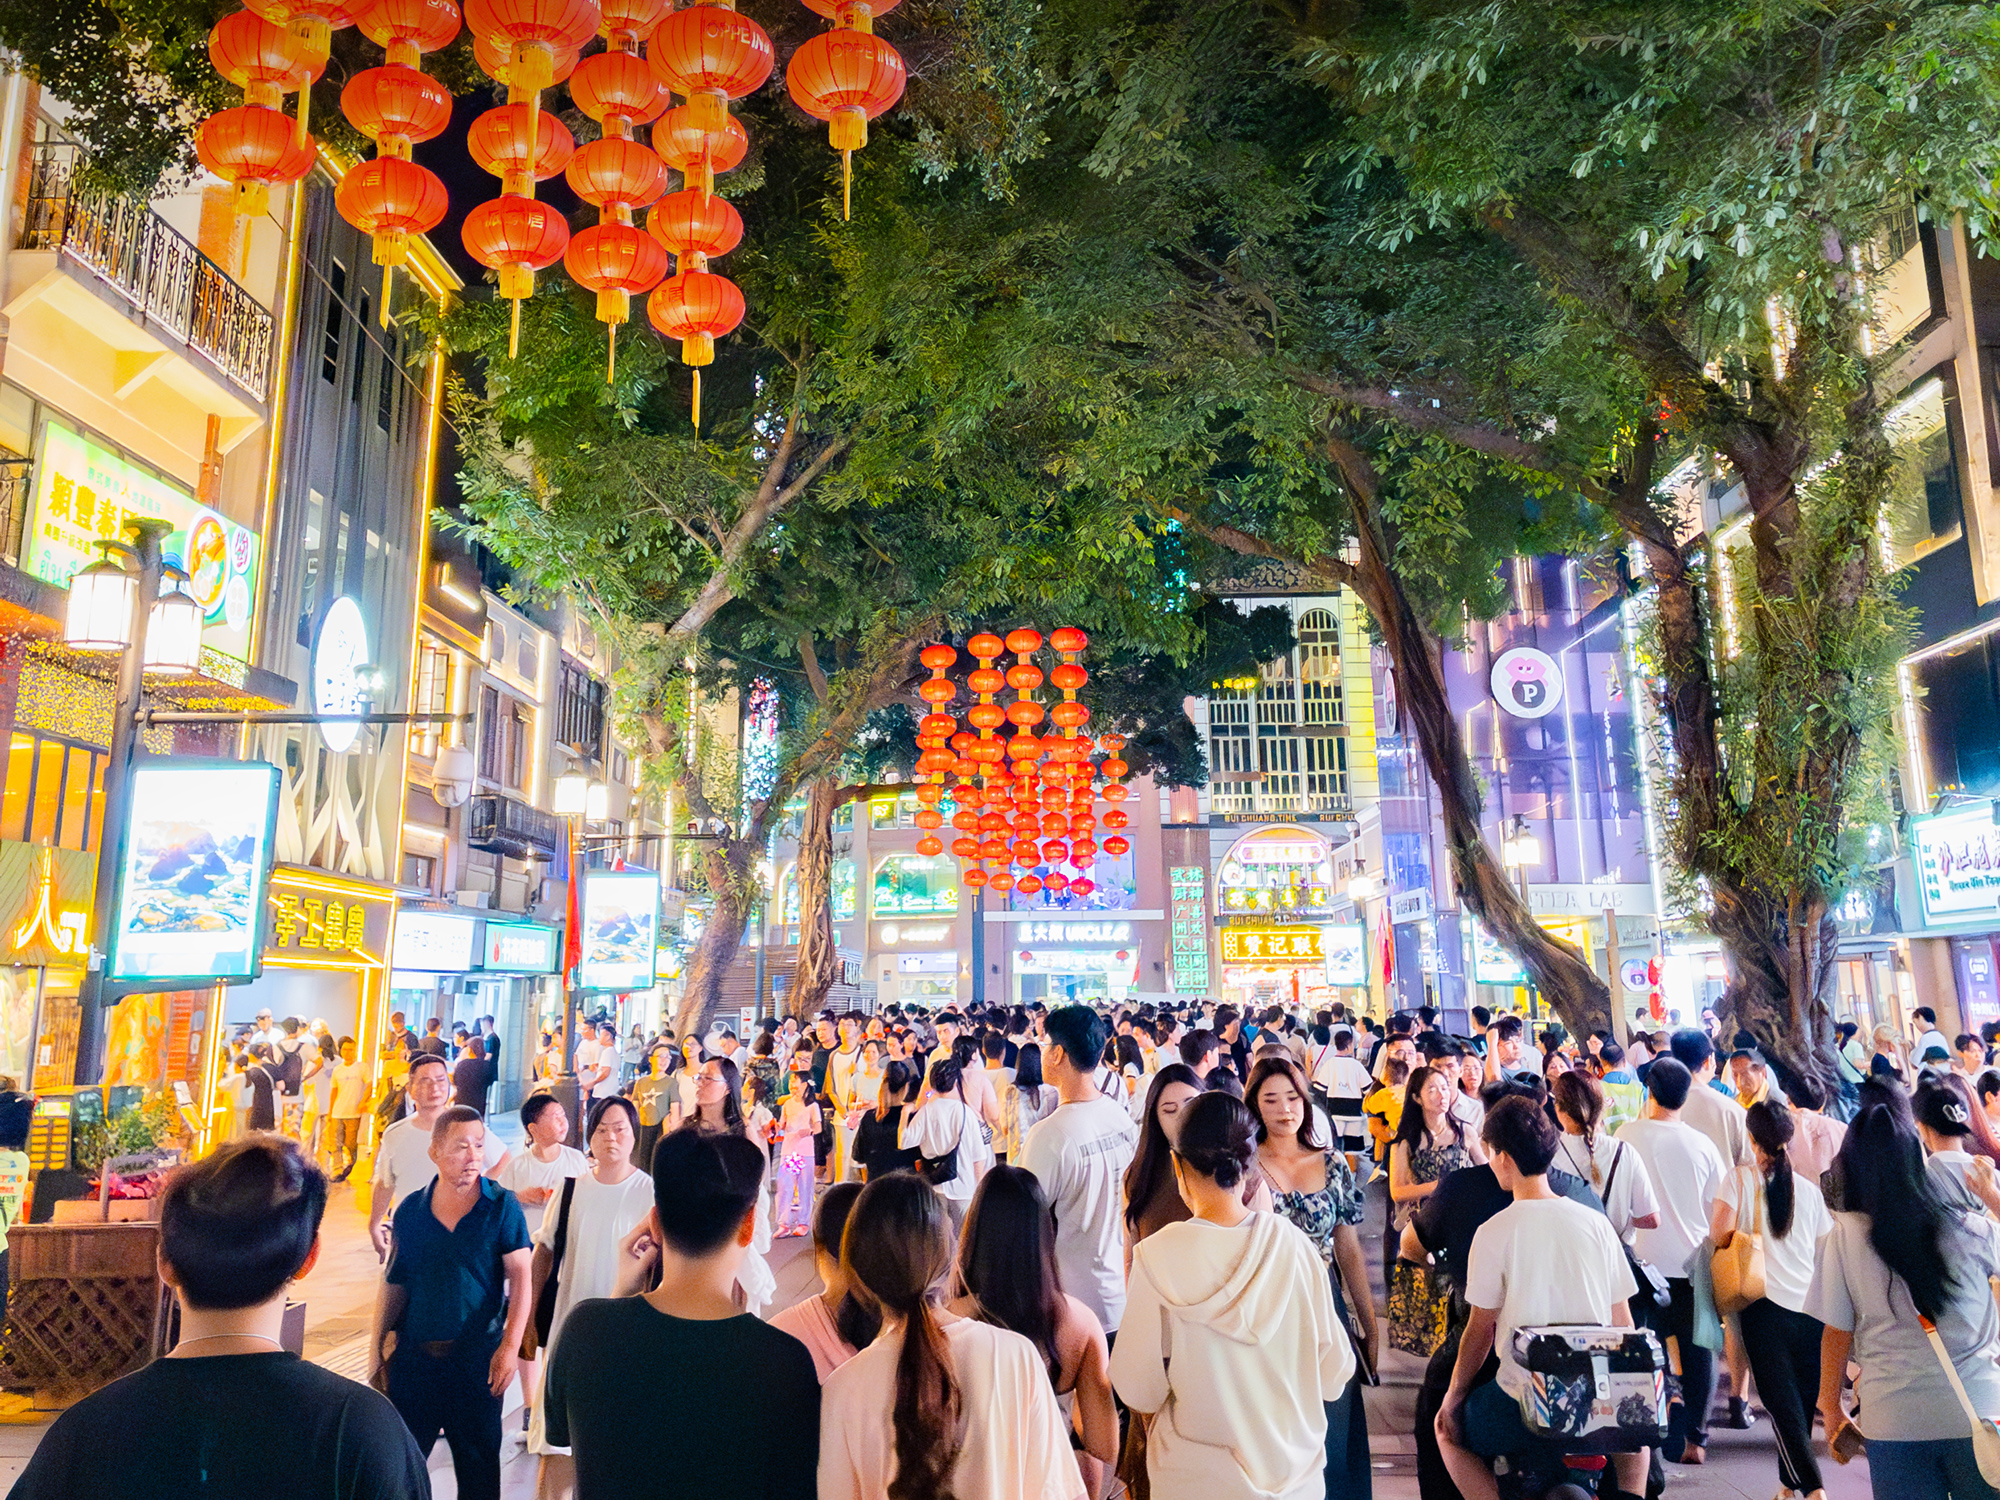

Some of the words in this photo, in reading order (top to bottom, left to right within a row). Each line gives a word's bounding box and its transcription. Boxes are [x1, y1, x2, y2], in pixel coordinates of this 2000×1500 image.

[1522, 684, 1538, 703] P
[1170, 867, 1204, 883] 武林
[1172, 886, 1204, 902] 厨神
[1589, 891, 1623, 908] LAB
